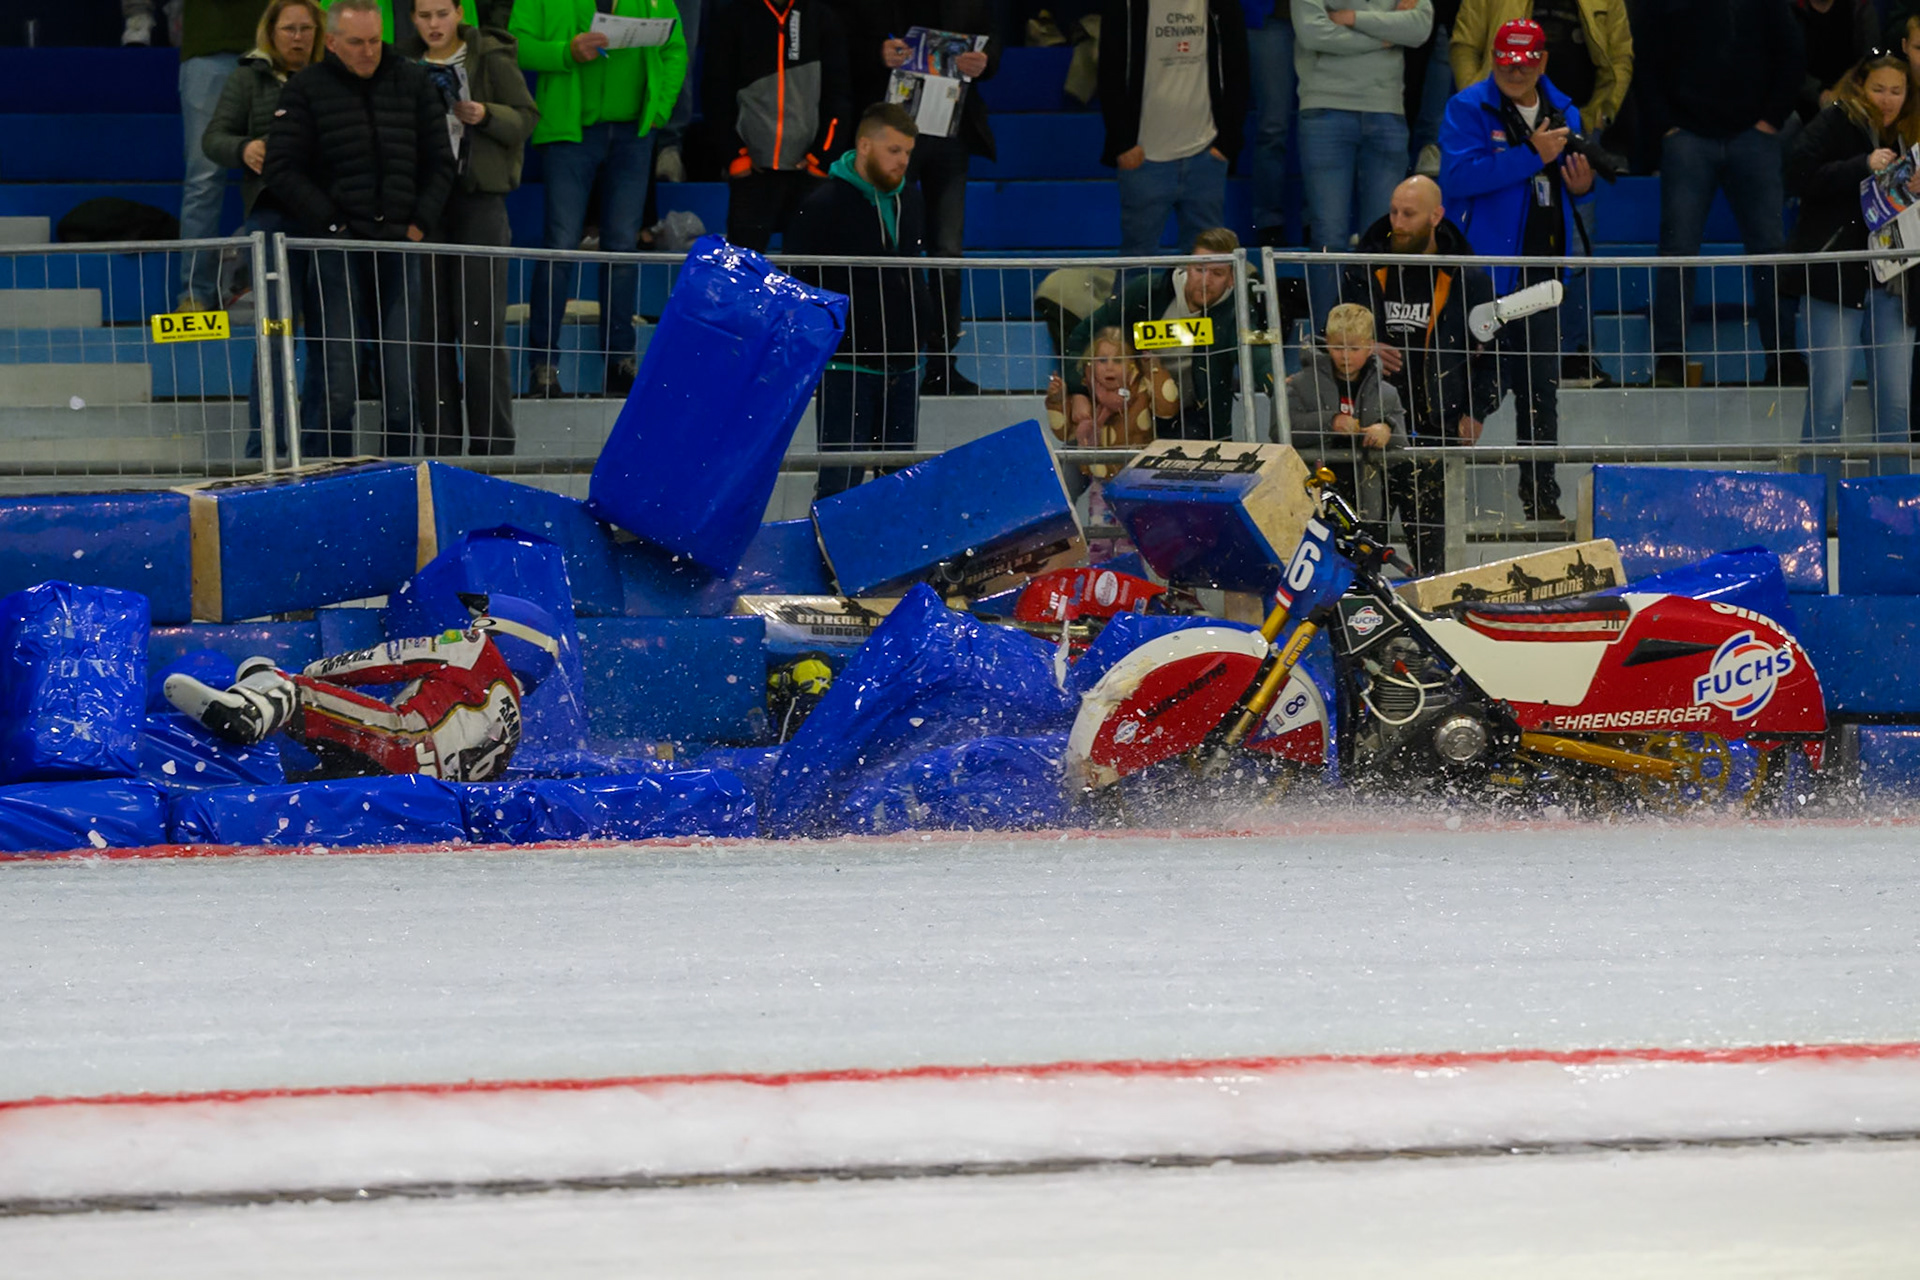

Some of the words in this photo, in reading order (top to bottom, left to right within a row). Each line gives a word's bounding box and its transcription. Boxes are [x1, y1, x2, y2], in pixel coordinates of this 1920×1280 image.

[160, 314, 222, 333] D.E.V.
[1142, 321, 1206, 340] D.EV.
[1349, 616, 1382, 625] FUCHS
[1698, 650, 1791, 701] FUCHS
[1554, 706, 1711, 730] EHRENSBERGER
